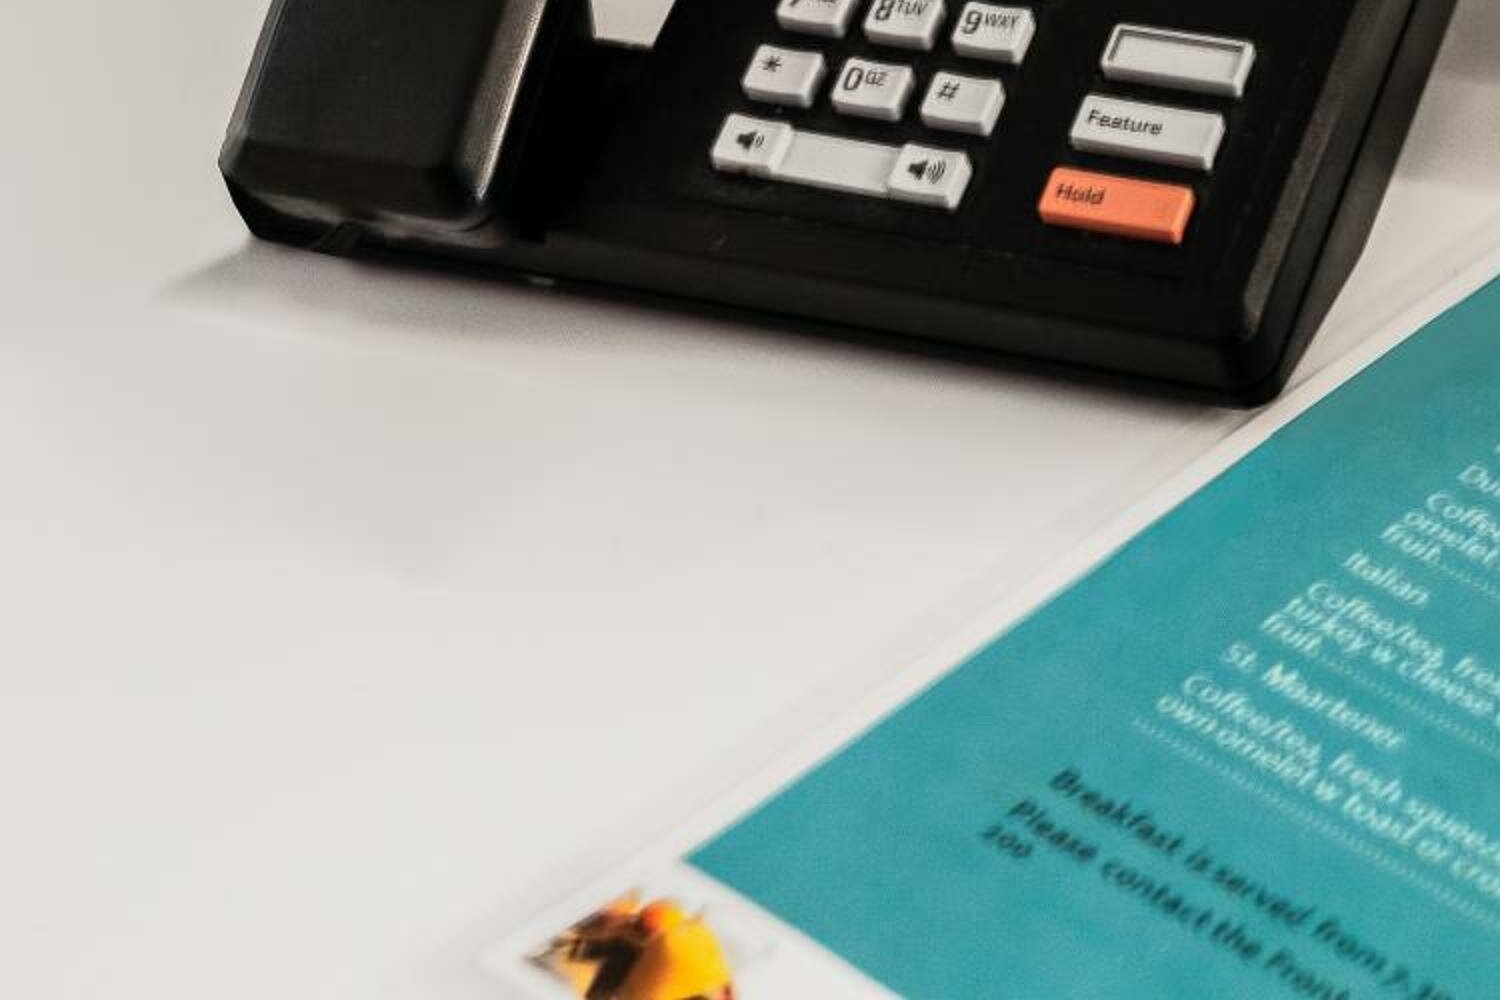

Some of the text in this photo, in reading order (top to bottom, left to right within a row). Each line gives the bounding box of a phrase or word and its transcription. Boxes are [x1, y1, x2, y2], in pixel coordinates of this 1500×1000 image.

[1086, 109, 1164, 136] Feature
[1055, 183, 1106, 206] Hold
[1379, 521, 1441, 564] fruit
[1342, 549, 1430, 606] Italian
[1259, 610, 1322, 654] fruit
[1268, 595, 1377, 653] turkey
[1215, 728, 1324, 787] omelet
[1342, 792, 1425, 845] toast
[1321, 753, 1411, 804] fresh
[998, 800, 1098, 862] Please
[1101, 861, 1217, 931] contact
[1211, 921, 1263, 966] the
[1049, 769, 1185, 857] Breakfast
[1212, 864, 1316, 927] served
[1309, 916, 1387, 974] from
